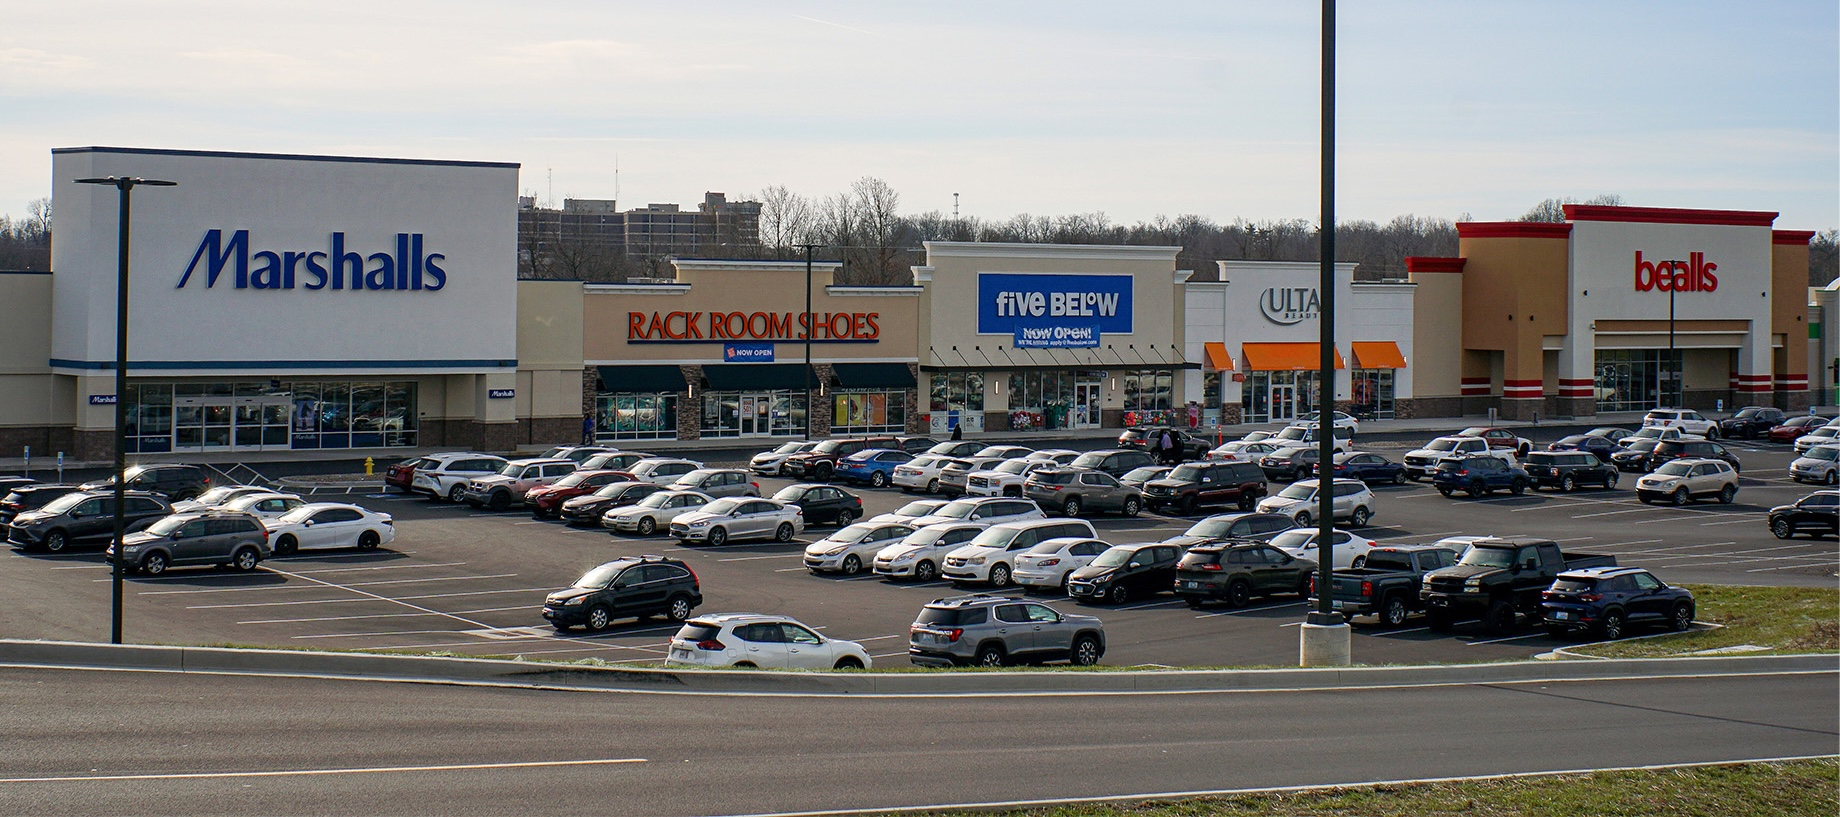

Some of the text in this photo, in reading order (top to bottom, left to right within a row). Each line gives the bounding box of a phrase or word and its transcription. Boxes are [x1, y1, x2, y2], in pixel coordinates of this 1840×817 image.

[176, 229, 447, 290] Marshalls
[1635, 250, 1718, 292] bealls
[996, 291, 1119, 317] five BELOW
[1269, 288, 1321, 312] ULTA
[628, 311, 880, 339] RACK ROOM SHOES
[1023, 327, 1053, 339] NOW
